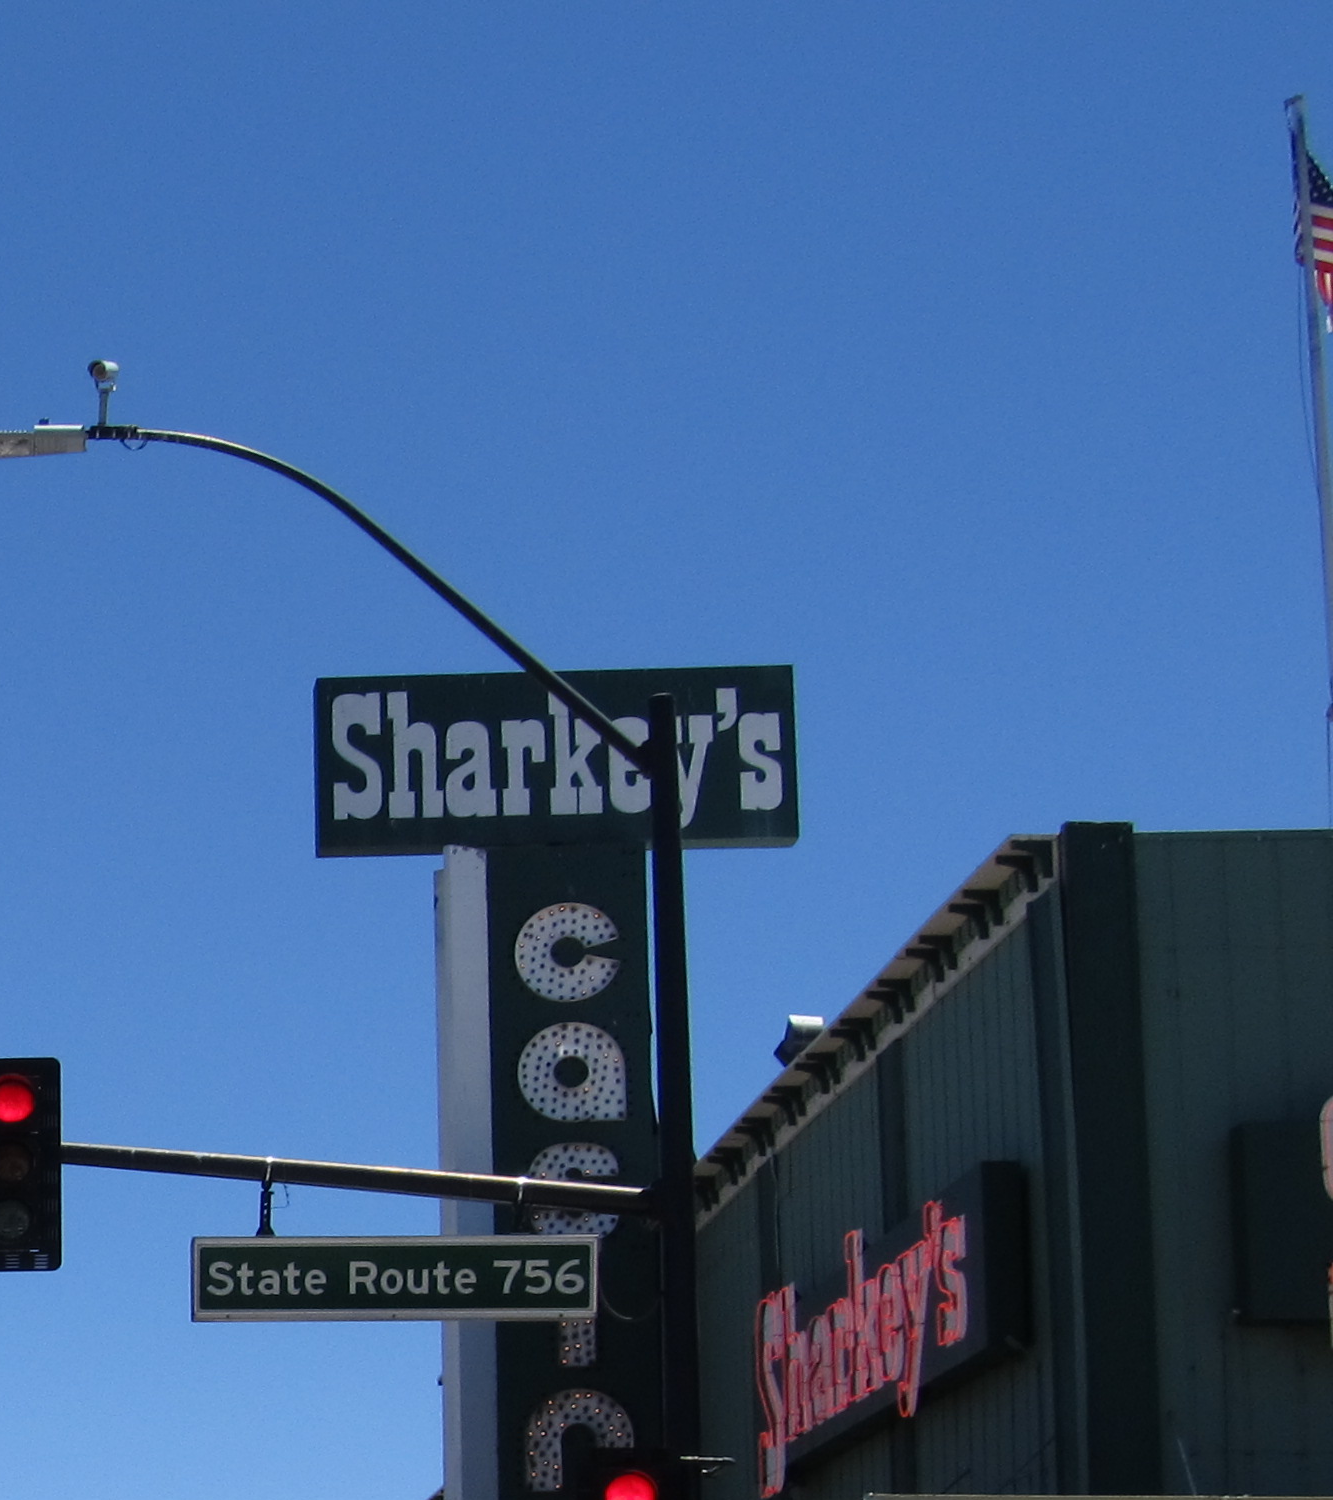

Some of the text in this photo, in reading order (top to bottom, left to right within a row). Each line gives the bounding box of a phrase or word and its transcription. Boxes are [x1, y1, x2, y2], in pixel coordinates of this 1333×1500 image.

[331, 687, 784, 830] Sharkey's
[206, 1258, 586, 1297] State Route 756
[755, 1199, 968, 1499] Sharkey's
